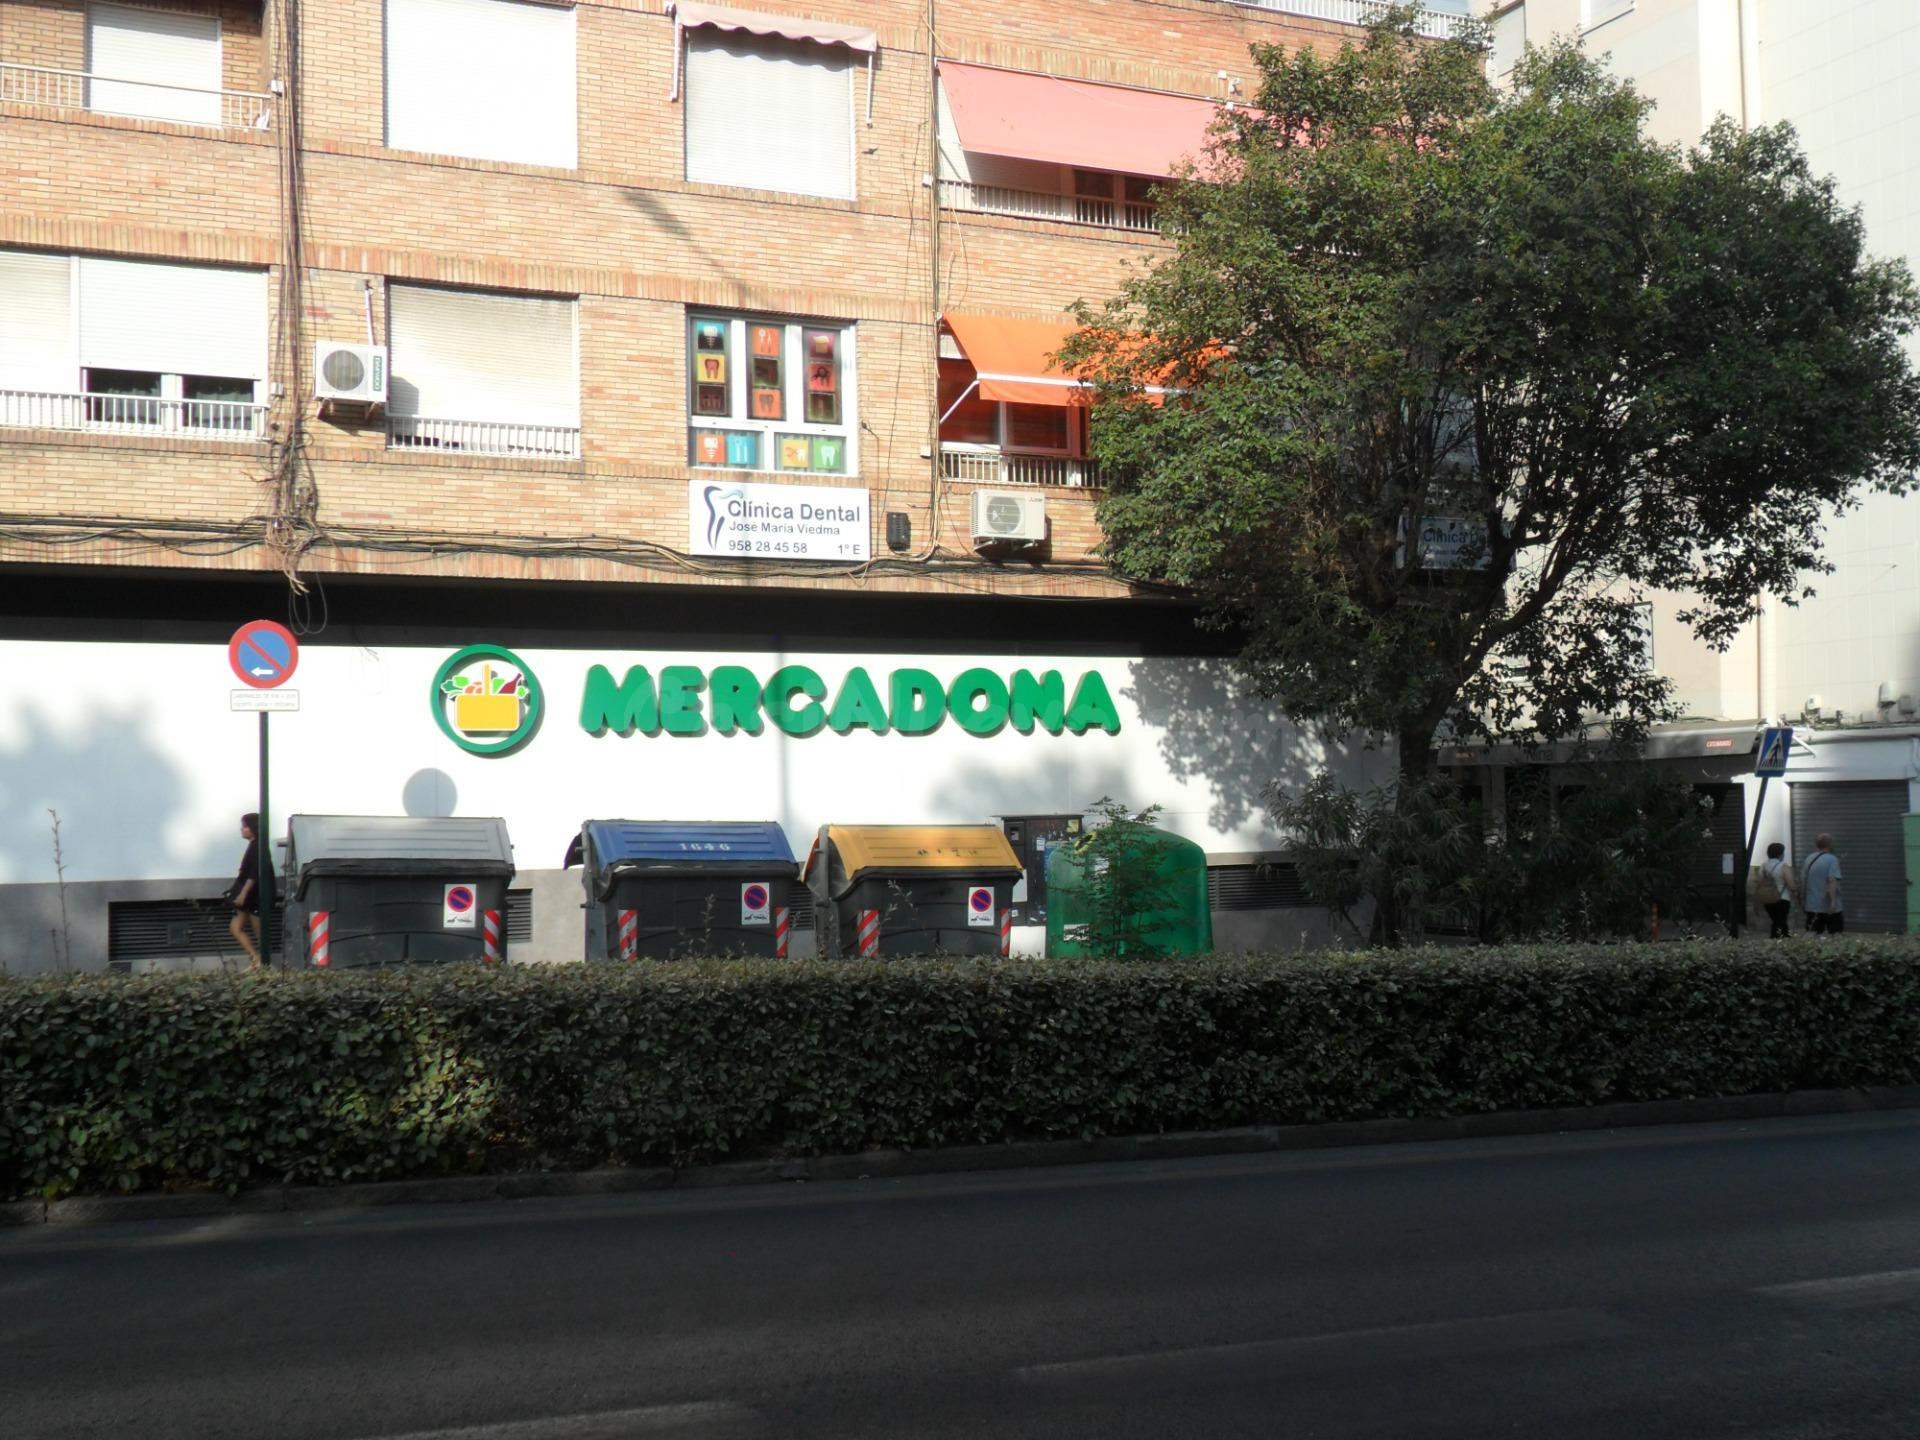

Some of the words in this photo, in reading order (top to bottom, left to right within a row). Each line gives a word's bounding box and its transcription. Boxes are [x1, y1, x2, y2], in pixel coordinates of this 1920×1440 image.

[728, 500, 793, 519] Clínica
[800, 503, 860, 522] Dental
[729, 522, 757, 532] José
[797, 523, 840, 535] Viedma
[729, 540, 752, 551] 958
[756, 541, 771, 552] 28
[774, 541, 789, 553] 45
[793, 542, 808, 553] 58
[853, 544, 861, 555] E
[580, 664, 1121, 738] MERCADONA
